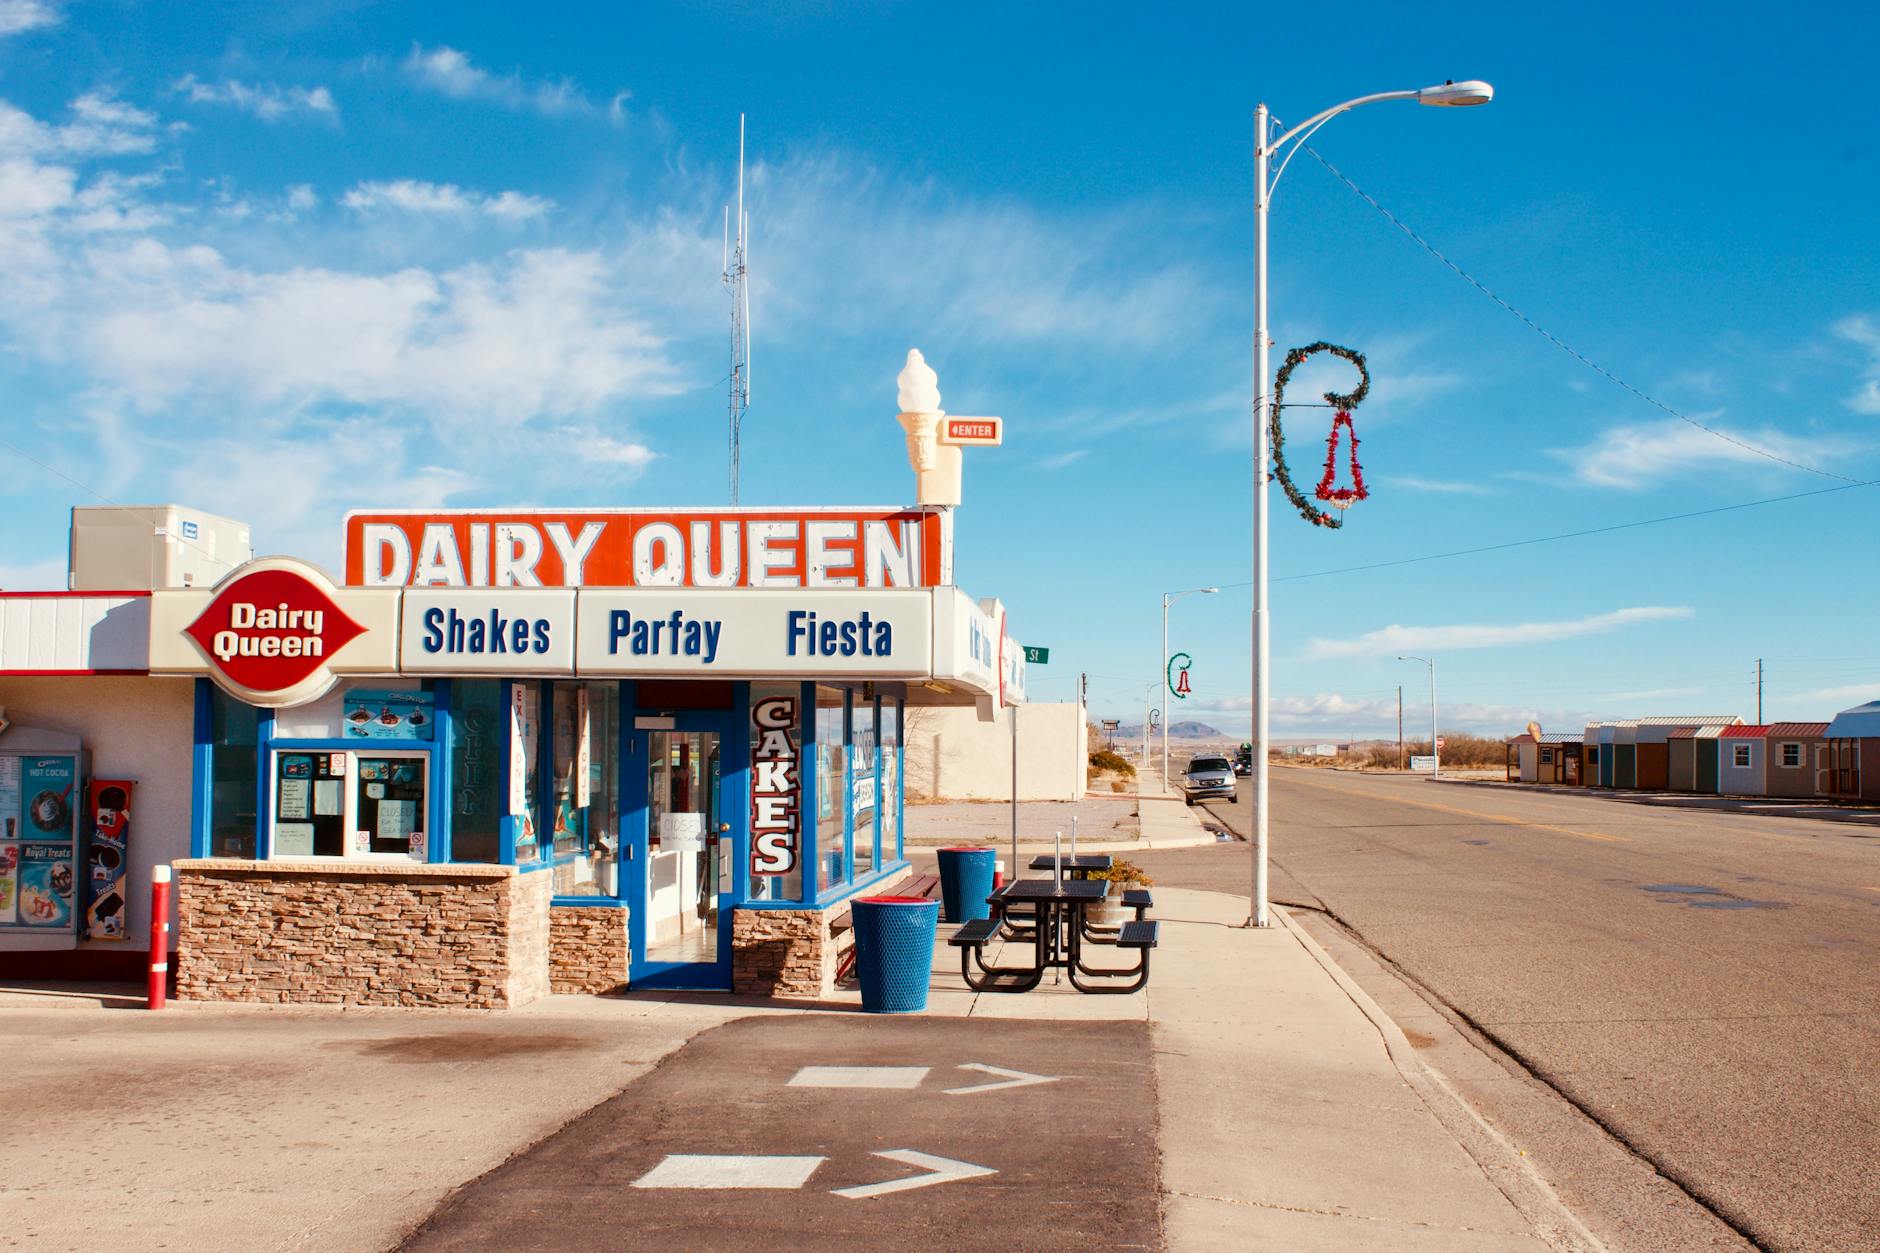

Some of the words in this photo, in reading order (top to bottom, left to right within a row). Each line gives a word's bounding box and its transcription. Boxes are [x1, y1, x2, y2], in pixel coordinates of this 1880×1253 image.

[958, 424, 992, 437] ENTER
[362, 521, 607, 588] DAIRY
[633, 520, 922, 588] QUEEN
[231, 602, 325, 636] Dairy
[423, 607, 551, 655] Shakes
[213, 630, 324, 663] Queen
[609, 609, 723, 664] Parfay
[786, 609, 892, 657] Fiesta
[1029, 648, 1039, 661] St
[29, 768, 44, 777] HOT
[45, 768, 69, 777] COCOA
[752, 698, 800, 876] CAKES
[381, 807, 413, 817] CLOSED
